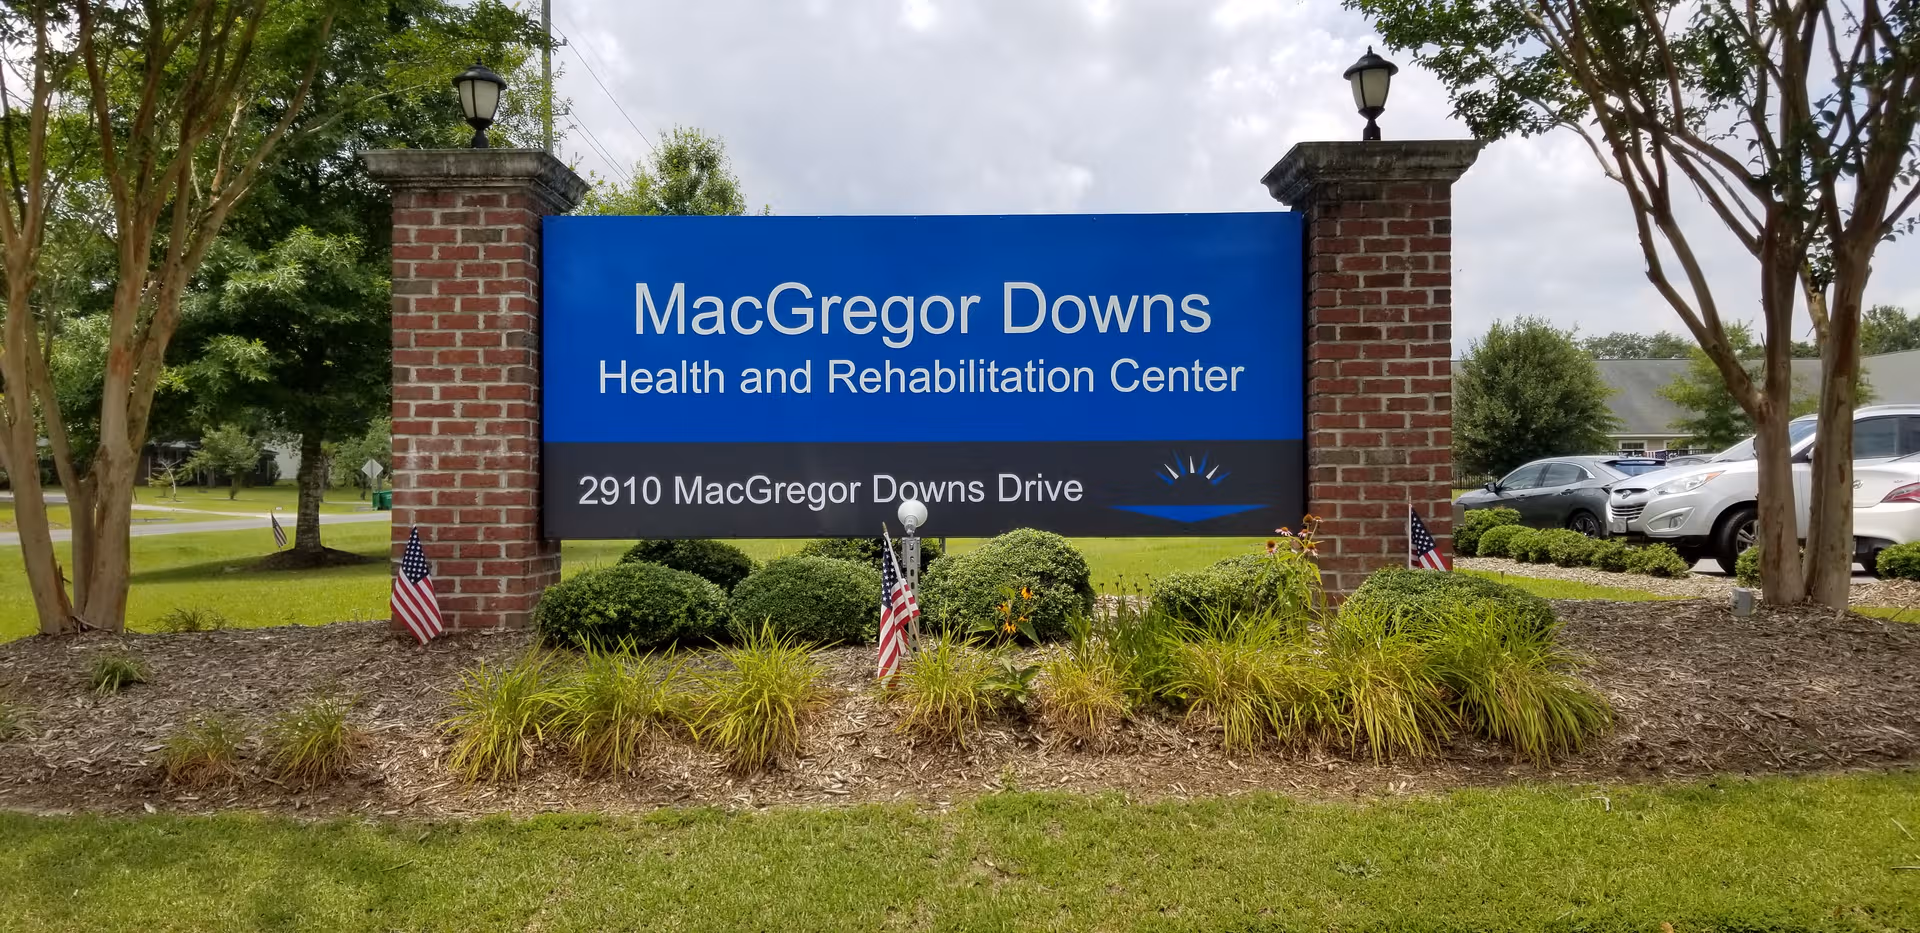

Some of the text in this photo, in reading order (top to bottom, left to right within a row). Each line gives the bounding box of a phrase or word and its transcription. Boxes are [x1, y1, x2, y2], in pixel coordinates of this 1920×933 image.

[633, 281, 1212, 348] MacGregor Downs
[598, 357, 1245, 394] Health and Rehabilitation Center
[578, 473, 1084, 511] 2910 MacGregor Downs Drive
